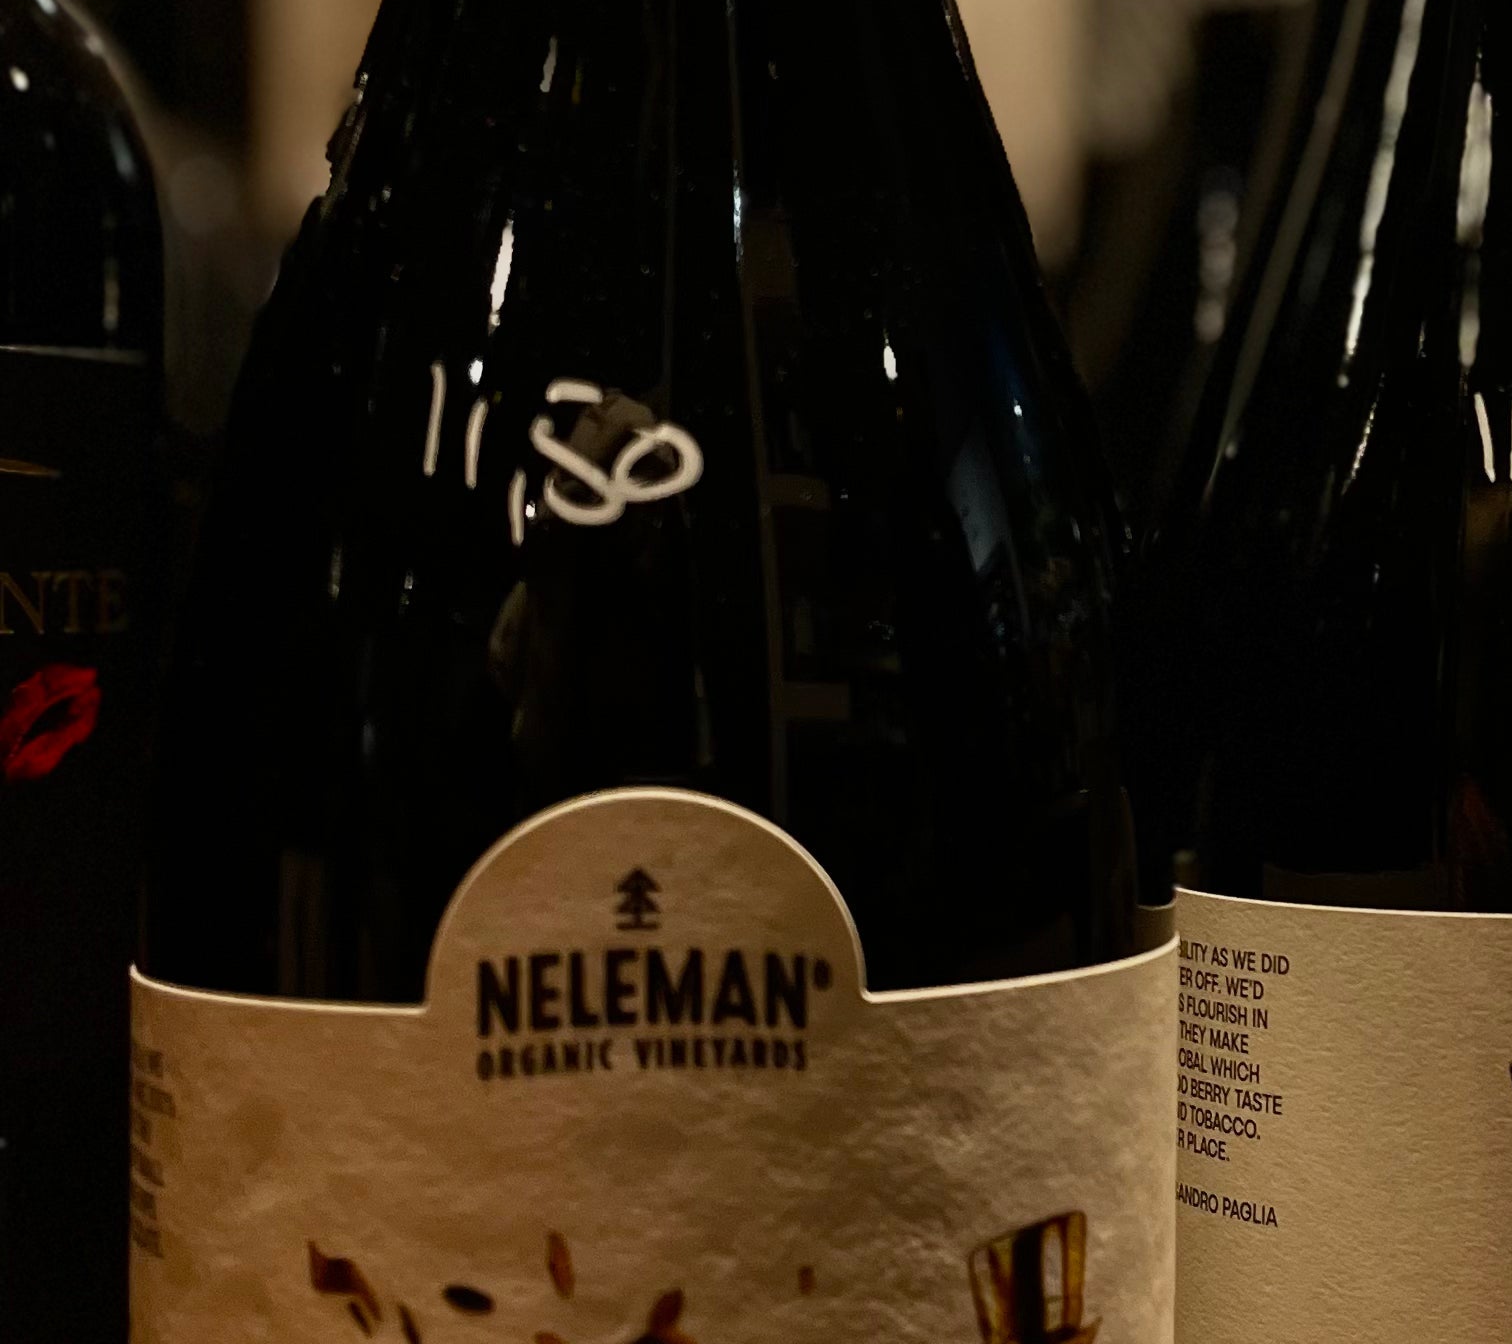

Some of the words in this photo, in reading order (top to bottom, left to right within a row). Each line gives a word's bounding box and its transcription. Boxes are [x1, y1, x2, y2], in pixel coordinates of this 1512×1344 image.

[1211, 946, 1229, 968] AS
[1232, 949, 1256, 973] WE
[1261, 953, 1290, 975] DID
[1195, 970, 1222, 994] OFF.
[1225, 975, 1264, 1000] WE'D
[1186, 995, 1248, 1026] FLOURISH
[1252, 1008, 1269, 1030] IN
[1179, 1019, 1207, 1046] THEY
[1209, 1027, 1249, 1054] MAKE
[476, 1039, 613, 1081] ORGANIC
[633, 1038, 808, 1072] VINEYARDS
[1210, 1055, 1260, 1084] WHICH
[1190, 1078, 1231, 1106] BERRY
[1234, 1088, 1283, 1116] TASTE
[1189, 1104, 1261, 1140] TOBACCO.
[1187, 1131, 1231, 1162] PLACE.
[1176, 1182, 1219, 1214] ANDRO
[1222, 1196, 1279, 1227] PAGLIA
